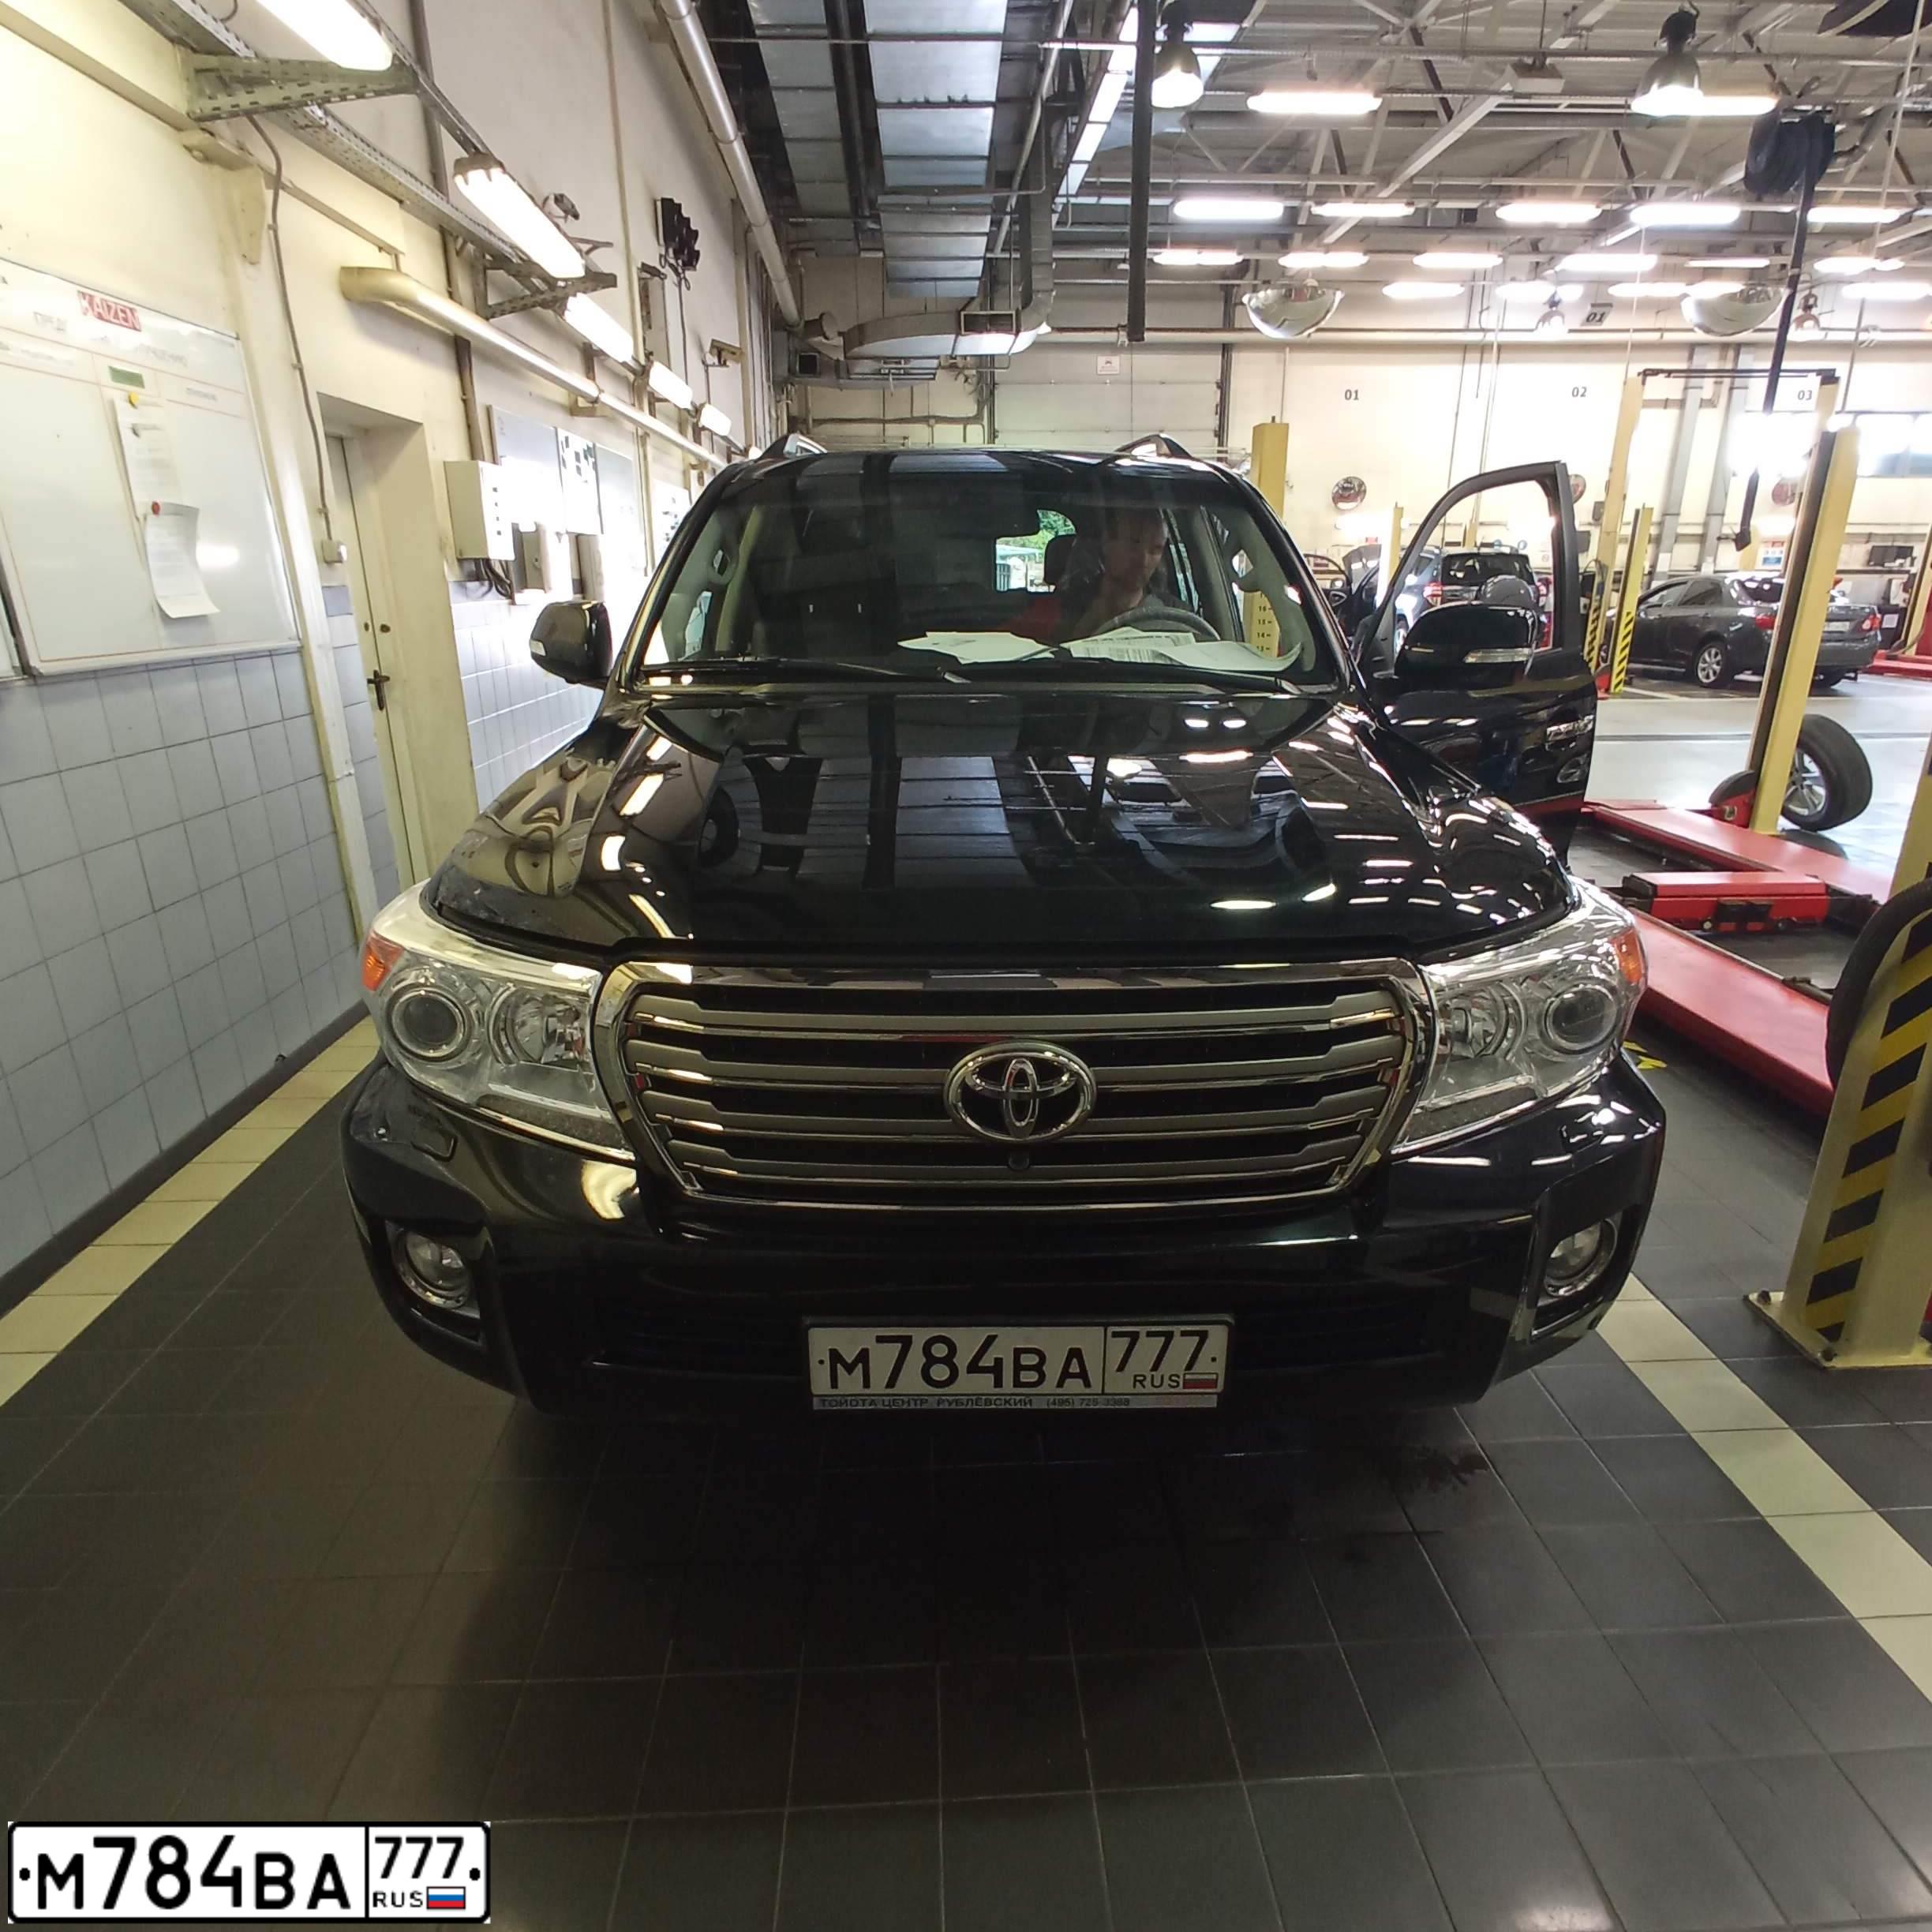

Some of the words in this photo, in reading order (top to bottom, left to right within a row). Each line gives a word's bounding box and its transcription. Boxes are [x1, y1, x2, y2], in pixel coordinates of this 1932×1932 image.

[80, 291, 141, 331] KAIZEN
[1586, 312, 1605, 323] 01
[1344, 388, 1359, 401] 01
[1572, 386, 1587, 398] 02
[1797, 389, 1813, 401] 03
[828, 1334, 1092, 1390] М784ВА
[1110, 1329, 1209, 1373] 777
[1132, 1373, 1181, 1389] RUS
[882, 1398, 929, 1409] ЦЕНТР
[1046, 1397, 1075, 1408] (495)
